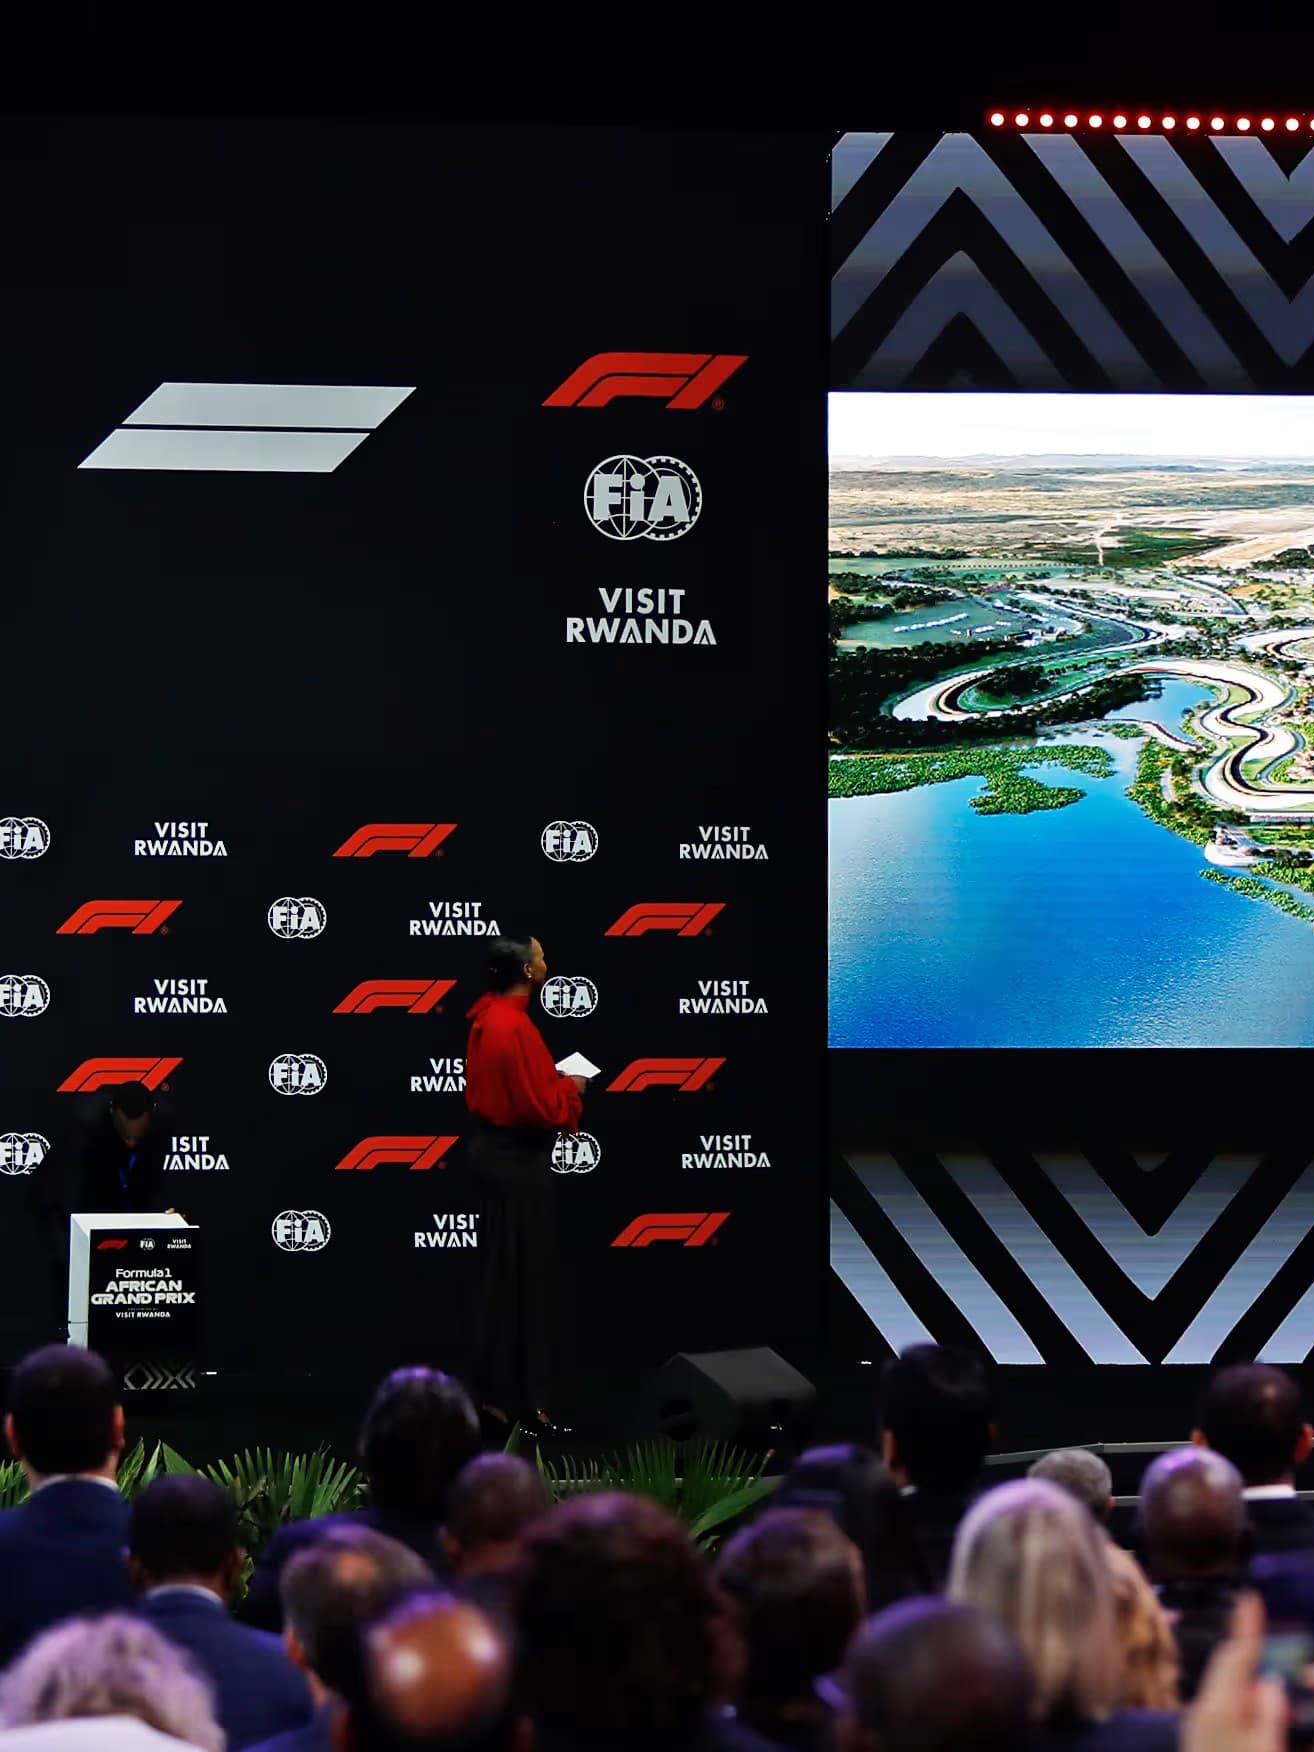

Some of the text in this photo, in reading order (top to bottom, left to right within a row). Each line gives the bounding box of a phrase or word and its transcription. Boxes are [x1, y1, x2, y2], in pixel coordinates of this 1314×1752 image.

[599, 588, 685, 614] VISIT
[567, 617, 717, 645] RWANDA
[154, 822, 208, 838] VISIT
[699, 826, 750, 841] VISIT
[135, 840, 227, 856] RWANDA
[680, 844, 768, 859] RWANDA
[429, 902, 481, 918] VISIT
[410, 920, 501, 936] RWANDA
[154, 979, 208, 995] VISIT
[698, 981, 749, 996] VISIT
[135, 997, 227, 1013] RWANDA
[680, 998, 768, 1013] RWANDA
[430, 1058, 463, 1074] VIS
[172, 1136, 209, 1152] ISIT
[700, 1135, 751, 1151] VISIT
[163, 1154, 230, 1170] ANDA
[682, 1152, 770, 1168] RWANDA
[433, 1214, 479, 1229] VISI
[415, 1232, 477, 1247] RWAN
[105, 1280, 182, 1292] AFRICAN
[91, 1292, 195, 1305] GRAND PRIX
